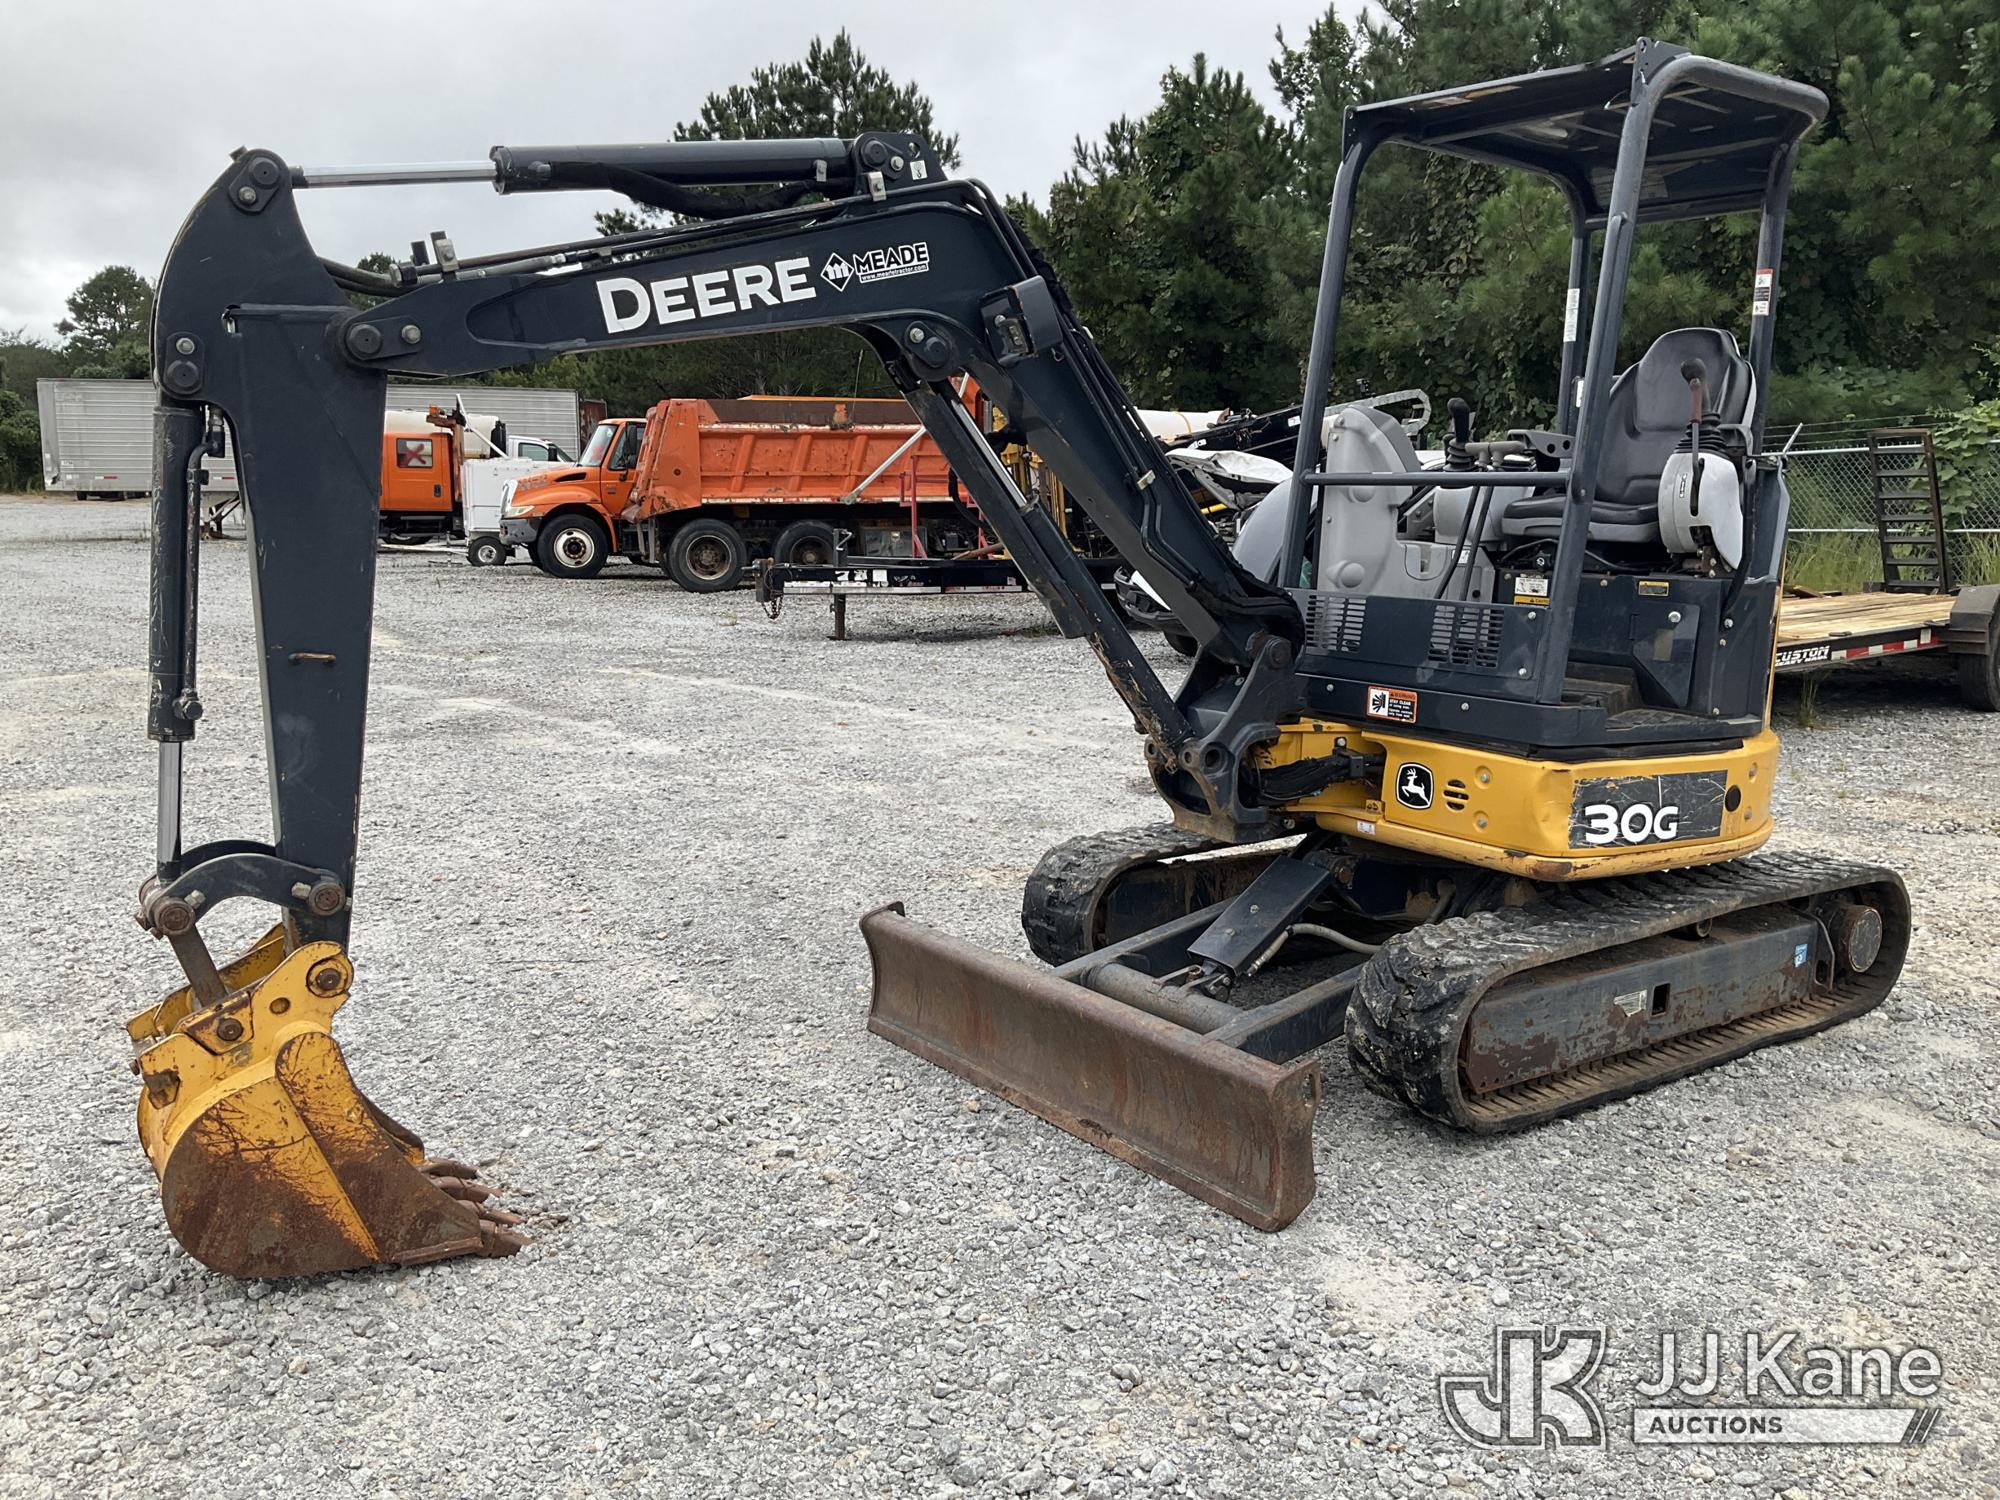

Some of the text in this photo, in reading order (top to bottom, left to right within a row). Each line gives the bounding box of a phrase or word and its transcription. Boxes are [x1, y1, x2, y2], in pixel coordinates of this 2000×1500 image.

[854, 242, 928, 274] MEADE
[596, 257, 817, 334] DEERE
[1585, 803, 1679, 844] 30G
